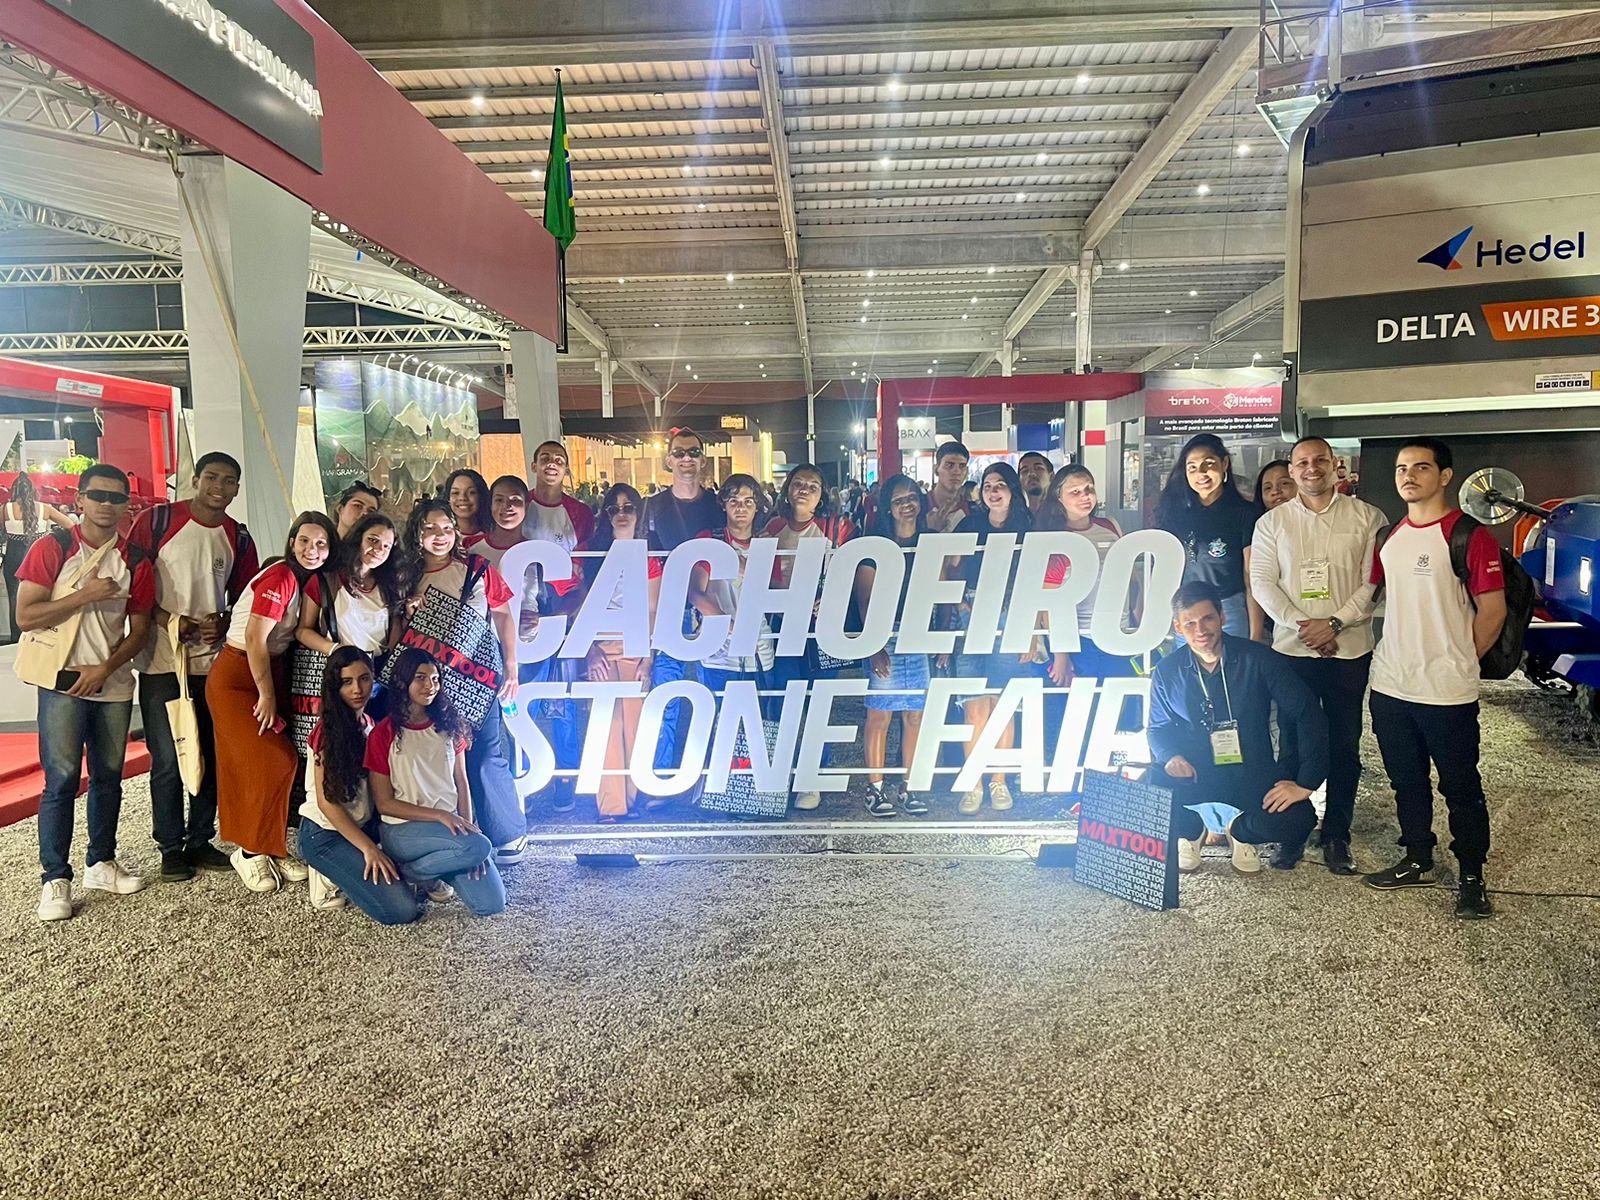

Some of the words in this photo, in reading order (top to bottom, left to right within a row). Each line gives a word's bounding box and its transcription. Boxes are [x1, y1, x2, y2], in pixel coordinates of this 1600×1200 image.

[1476, 231, 1585, 267] Hedel
[1377, 312, 1476, 343] DELTA
[1503, 305, 1578, 332] WIRE
[1585, 304, 1600, 326] 3
[1239, 396, 1272, 404] Mendes
[900, 429, 932, 439] BRAX
[500, 529, 1186, 663] CACHOEIRO
[402, 629, 498, 689] MAXTOOL
[439, 663, 464, 680] AXTOOL
[444, 687, 473, 708] AXTOOL
[503, 679, 870, 797] STONE
[906, 677, 1152, 792] FAIR
[1080, 817, 1166, 861] MAXTOOL
